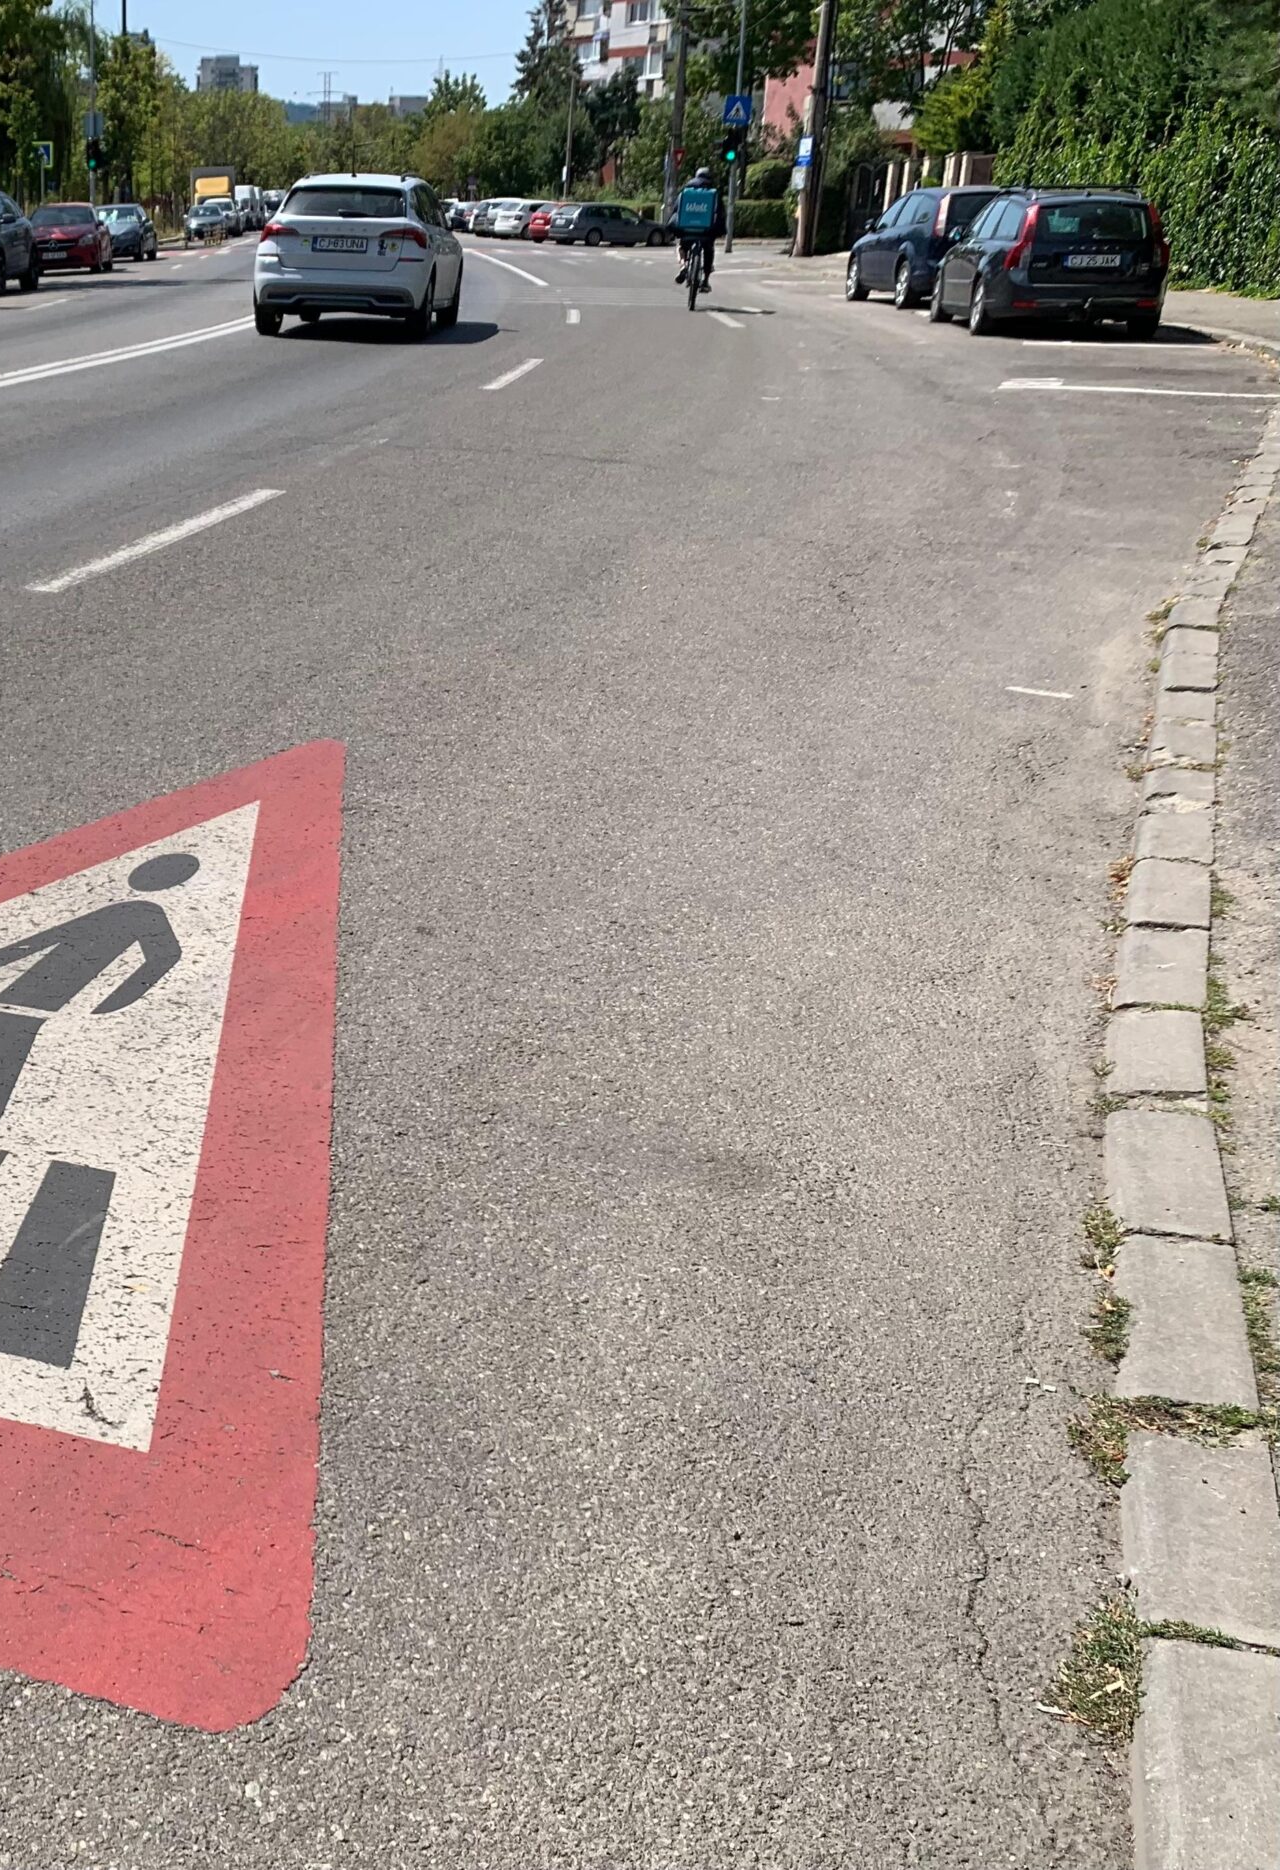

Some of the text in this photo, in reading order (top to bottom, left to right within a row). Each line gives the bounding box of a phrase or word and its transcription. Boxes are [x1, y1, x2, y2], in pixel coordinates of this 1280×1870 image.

[685, 202, 707, 212] Wolt
[319, 238, 331, 249] CJ
[1070, 255, 1083, 265] CJ
